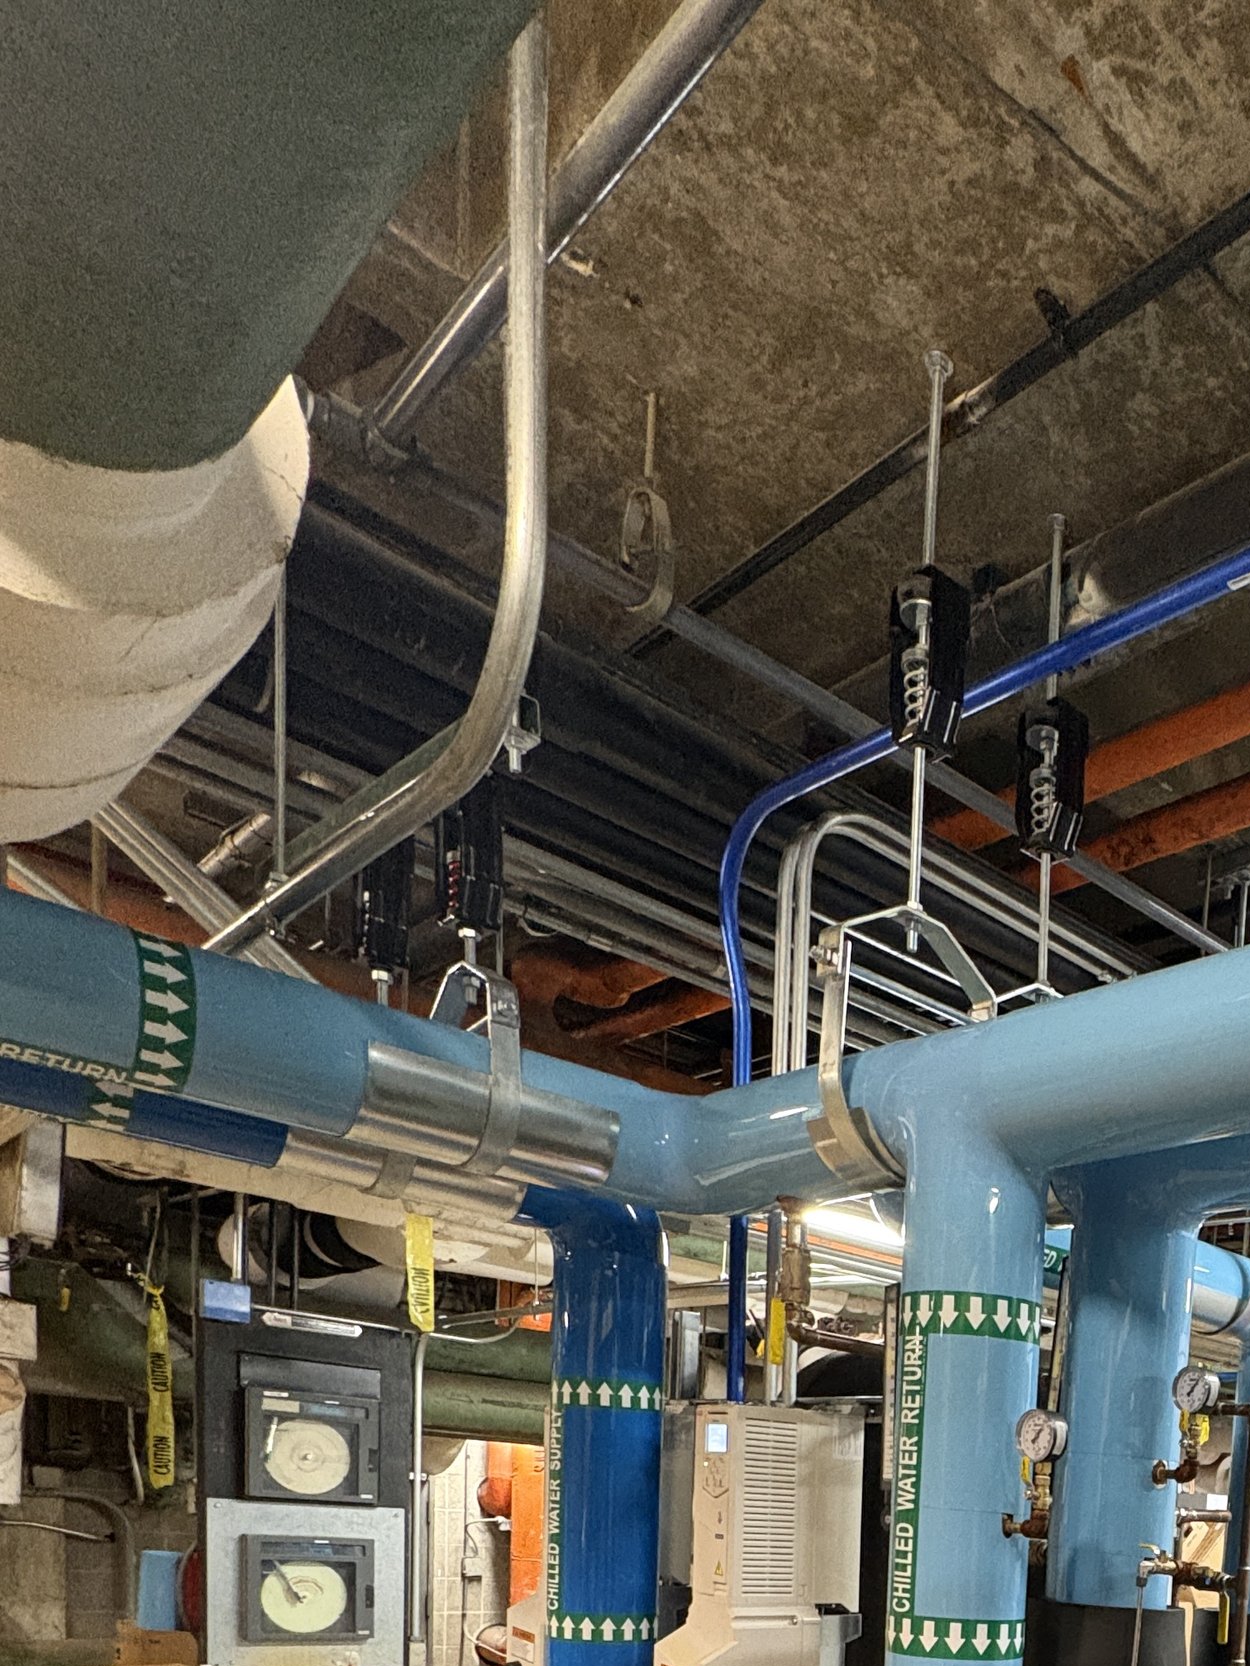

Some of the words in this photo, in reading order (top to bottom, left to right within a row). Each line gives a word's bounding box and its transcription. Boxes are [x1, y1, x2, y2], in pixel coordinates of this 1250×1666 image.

[0, 1043, 127, 1083] RETURN
[150, 1352, 170, 1392] CAUTION
[900, 1334, 924, 1424] RETURN
[153, 1436, 172, 1475] CAUTION
[549, 1408, 563, 1471] SUPPLY
[896, 1435, 918, 1511] WATER
[549, 1479, 561, 1534] WATER
[548, 1542, 560, 1611] CHILLED
[893, 1522, 914, 1613] CHILLED
